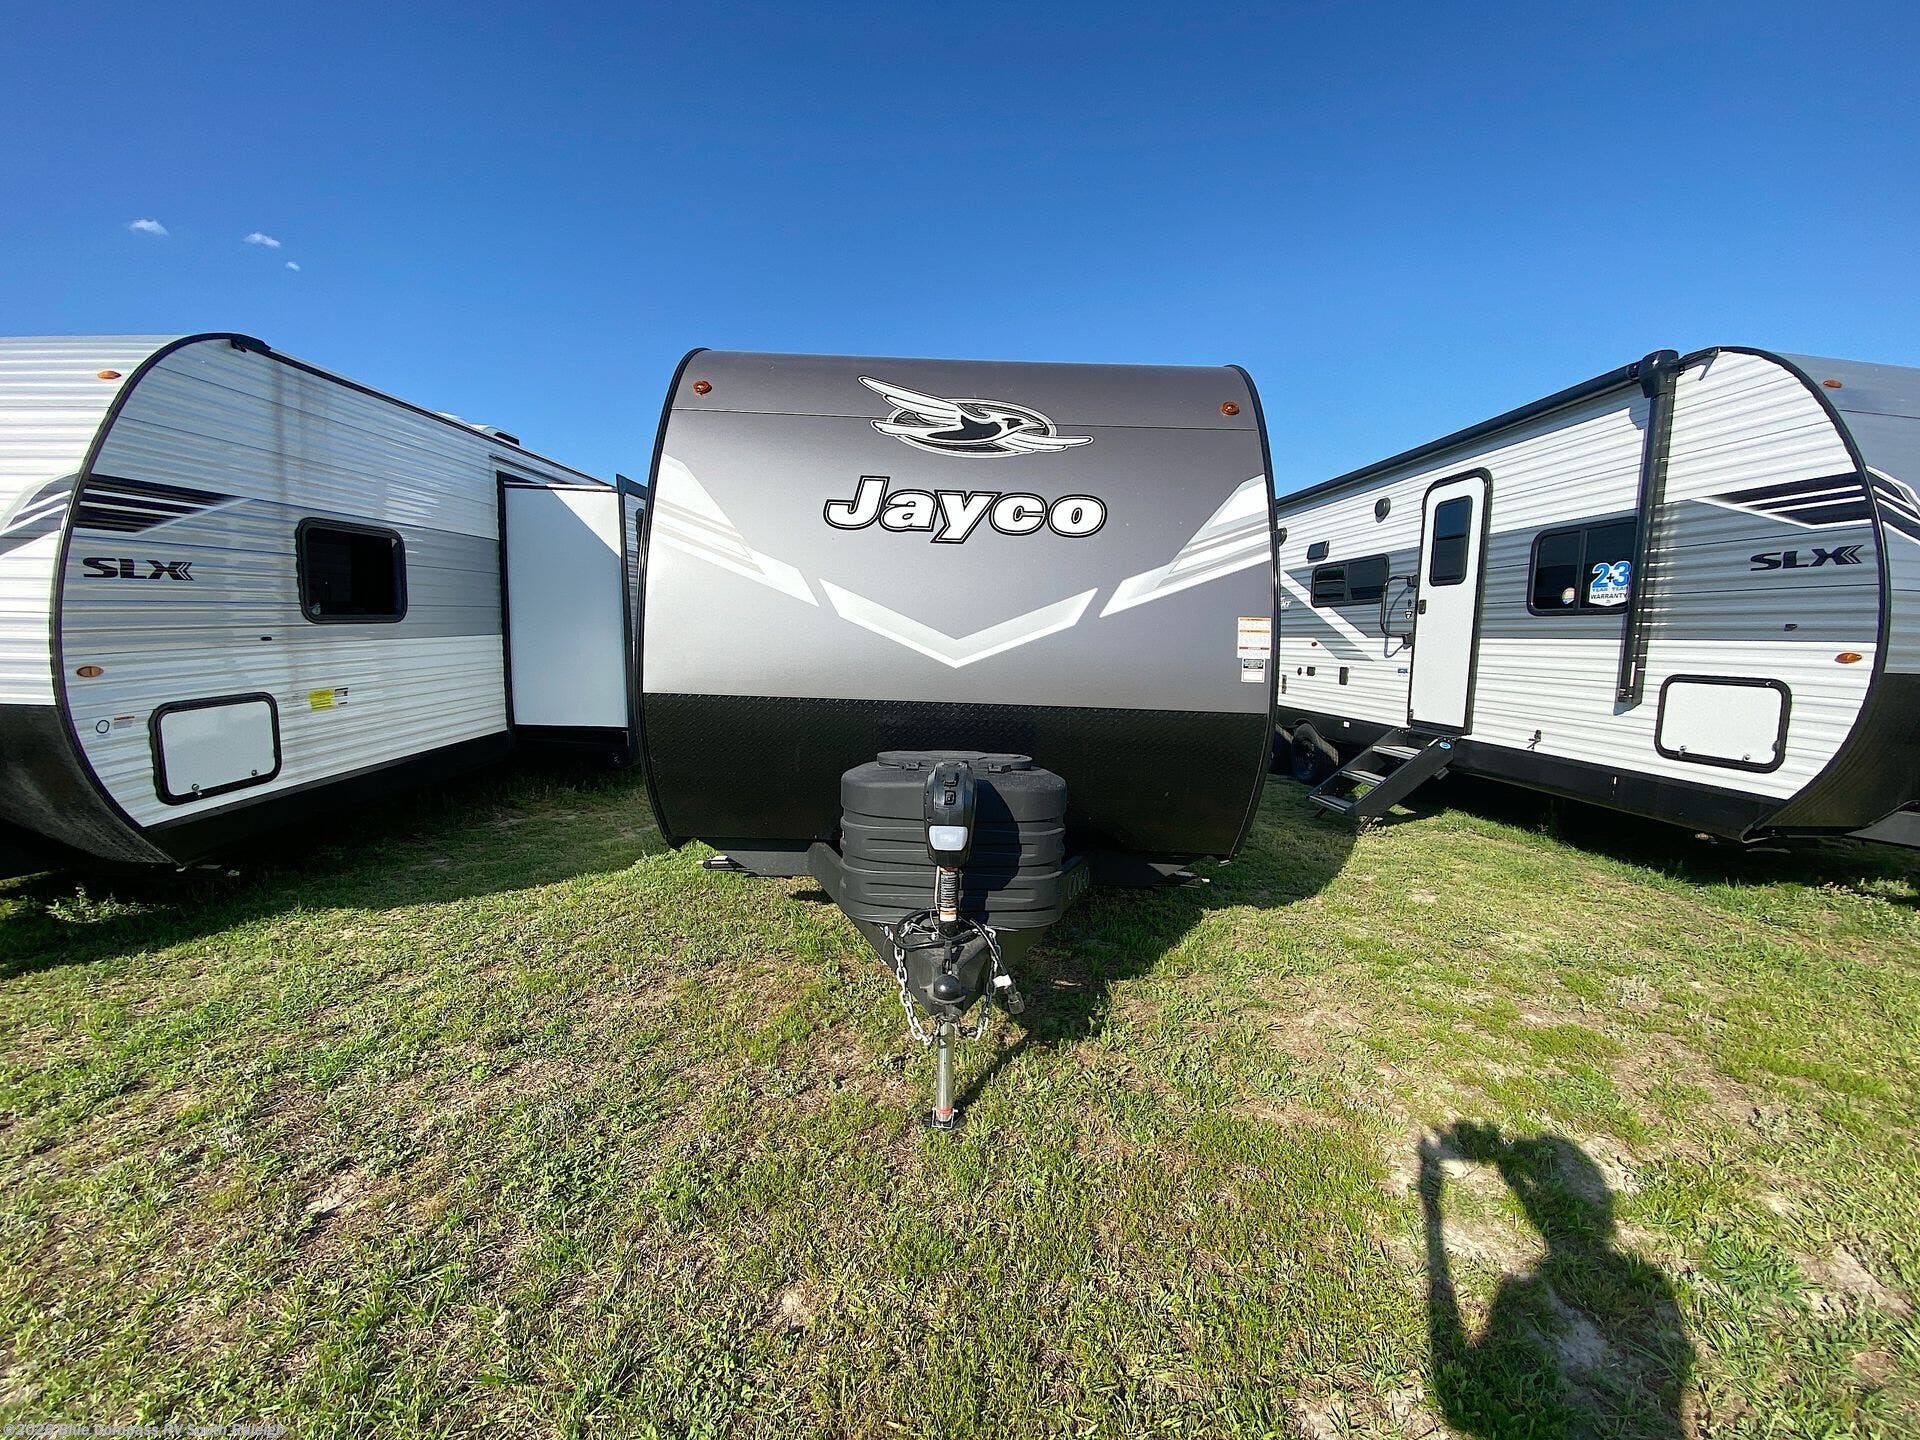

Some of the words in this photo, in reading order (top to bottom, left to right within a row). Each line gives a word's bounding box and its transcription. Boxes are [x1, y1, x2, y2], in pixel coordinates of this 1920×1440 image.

[823, 475, 1108, 544] Jayco
[84, 559, 194, 581] SLX
[1752, 546, 1864, 571] SLX
